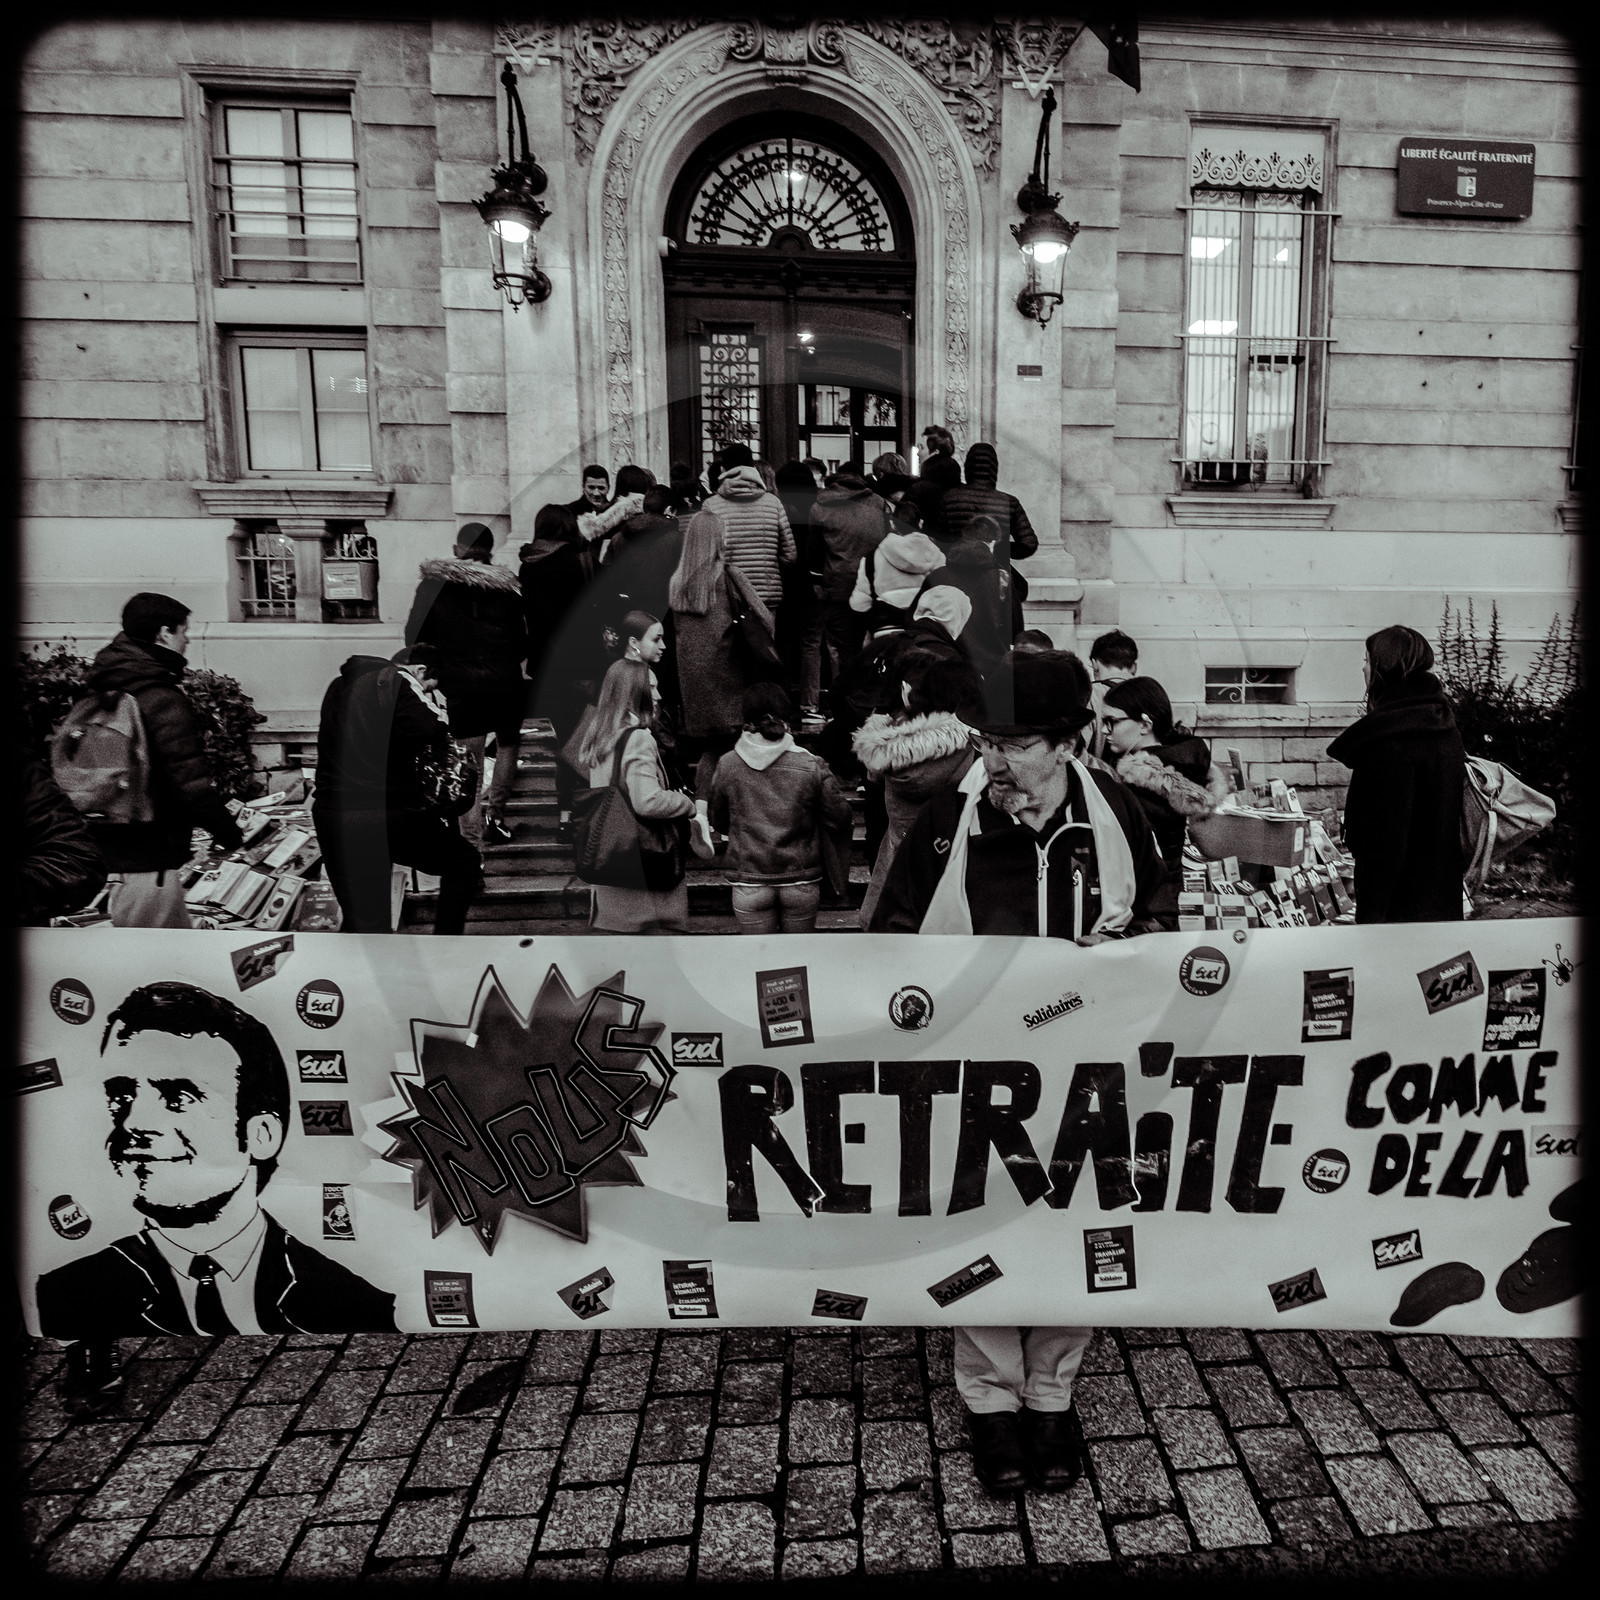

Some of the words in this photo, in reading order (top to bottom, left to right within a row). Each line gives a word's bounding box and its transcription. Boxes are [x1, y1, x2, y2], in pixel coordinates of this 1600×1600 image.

[1401, 148, 1438, 159] LIBERTÉ
[1439, 148, 1478, 162] ÉGALITÉ
[1478, 153, 1533, 164] FRATERNITÉ
[1195, 965, 1222, 981] Sud
[64, 996, 86, 1012] Sud
[311, 998, 336, 1013] Sud
[1022, 995, 1084, 1029] Solidaires
[672, 1036, 721, 1060] Sud
[299, 1053, 343, 1076] Sud
[1345, 1051, 1559, 1129] COMME
[301, 1103, 346, 1128] Sud
[1375, 1232, 1419, 1262] Sud
[1272, 1271, 1320, 1306] Sud
